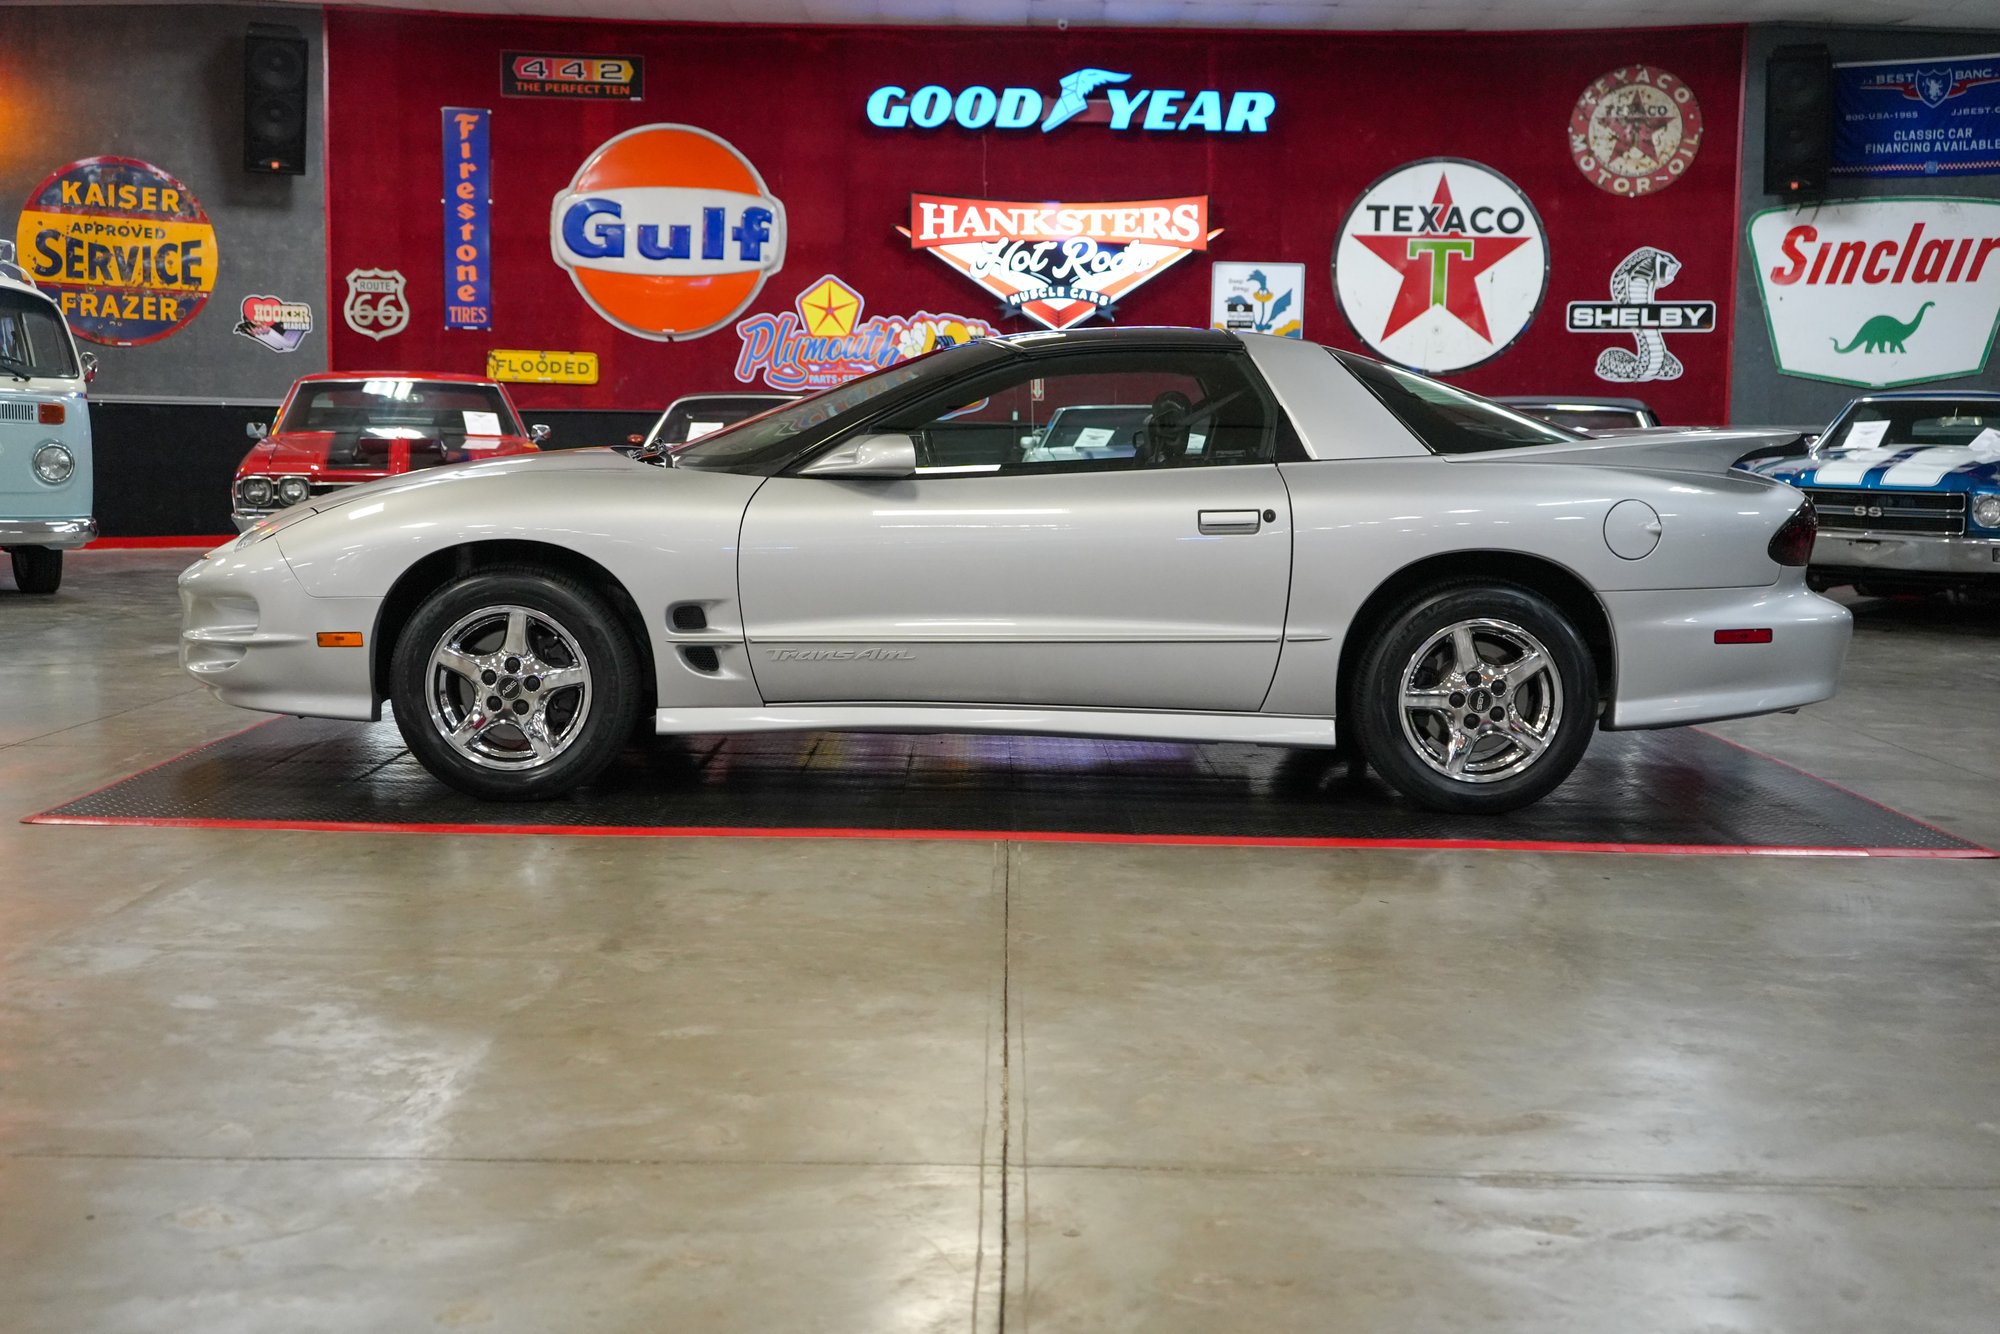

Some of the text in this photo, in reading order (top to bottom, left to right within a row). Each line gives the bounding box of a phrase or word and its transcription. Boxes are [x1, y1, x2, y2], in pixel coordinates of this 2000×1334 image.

[1876, 73, 1915, 85] BEST
[1955, 68, 1993, 81] BANC
[515, 81, 631, 95] THE PERFECT TEN
[1893, 127, 1973, 142] CLASSIC CAR
[1865, 138, 2000, 155] FINANCING AVAILABLE
[61, 180, 181, 212] KAISER
[454, 113, 480, 302] Firestone
[918, 201, 1201, 243] HANKSTERS
[1366, 204, 1525, 234] TEXACO
[70, 221, 166, 239] APPROVED
[562, 198, 773, 262] Gulf
[34, 229, 203, 286] SERVICE
[969, 236, 1160, 283] Hot Rods
[1769, 222, 2000, 287] Sinclair
[1408, 239, 1474, 307] T
[360, 281, 391, 291] ROUTE
[1009, 286, 1109, 307] MUSCLE CARS
[61, 292, 177, 322] FRAZER
[254, 304, 310, 323] HOOKER
[353, 294, 398, 327] 66
[449, 306, 487, 324] TIRES
[1572, 306, 1707, 328] SHELBY
[743, 319, 901, 384] Plymouth
[495, 358, 591, 377] FLOODED
[809, 374, 838, 385] PARTS
[1854, 505, 1883, 518] SS
[502, 680, 518, 697] ABS
